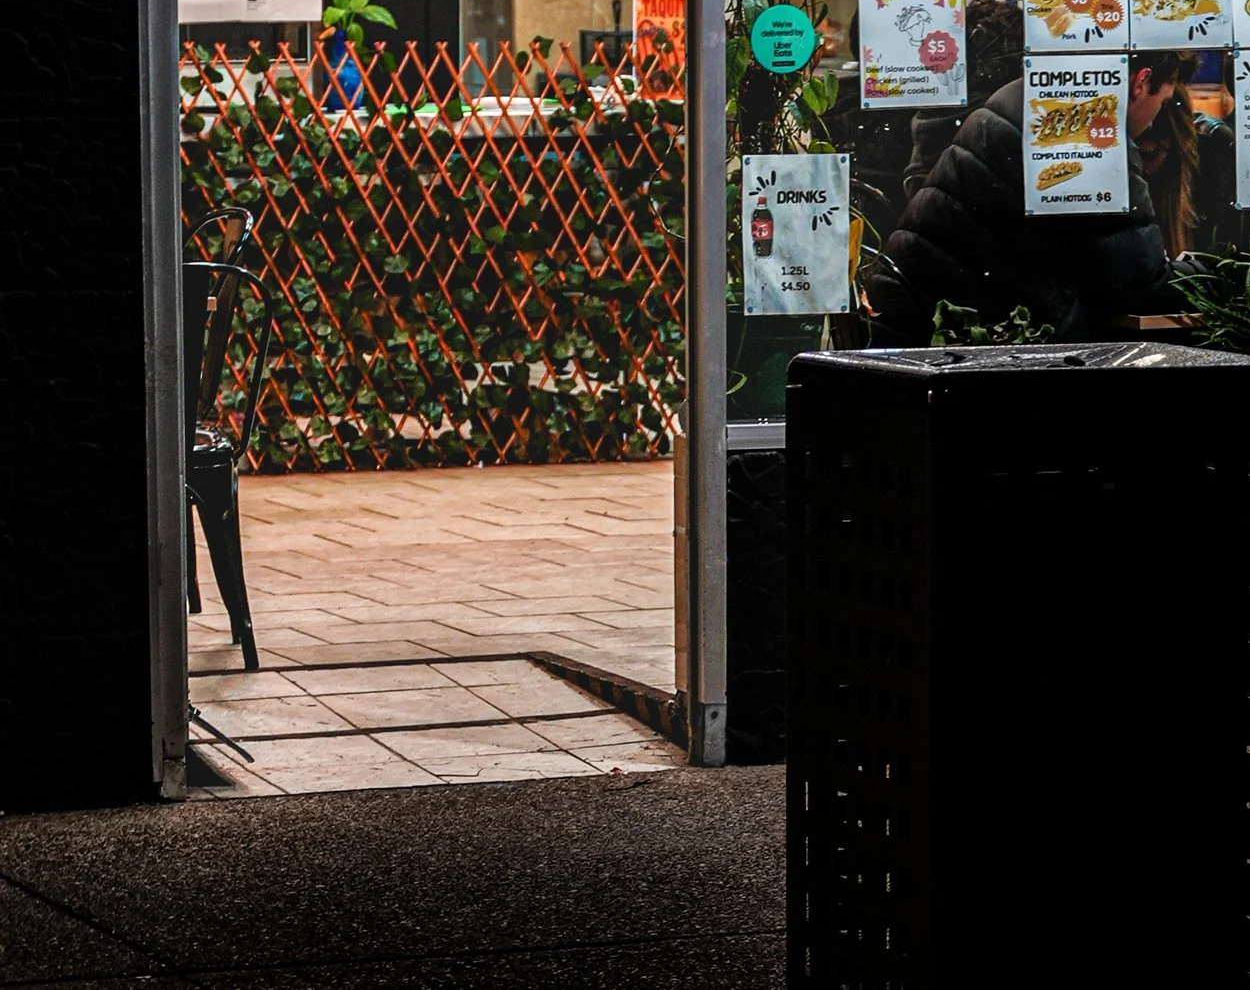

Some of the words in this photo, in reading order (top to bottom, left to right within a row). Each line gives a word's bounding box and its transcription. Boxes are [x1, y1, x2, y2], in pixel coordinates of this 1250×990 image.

[1096, 11, 1120, 23] $20
[761, 30, 794, 38] delivered
[795, 30, 804, 38] by
[774, 41, 792, 49] Uber
[928, 39, 945, 55] $5
[774, 50, 792, 58] Eats
[866, 65, 883, 73] Beef
[885, 65, 905, 73] (slow
[865, 76, 897, 85] Chicken
[900, 75, 929, 85] (grilled)
[1030, 70, 1121, 87] COMPLETOS
[907, 87, 939, 96] cooked)
[1039, 90, 1068, 99] CHILEAN
[1070, 90, 1098, 98] HOTDOG
[1090, 128, 1113, 139] $12
[1032, 151, 1070, 161] COMPLETO
[1071, 151, 1102, 159] ITALIANO
[777, 190, 827, 204] DRINKS
[1041, 194, 1062, 203] PLAIN
[1063, 194, 1092, 202] HOTDOG
[1096, 191, 1111, 203] $6
[781, 266, 809, 276] 1.25L
[781, 281, 810, 292] $4.50
